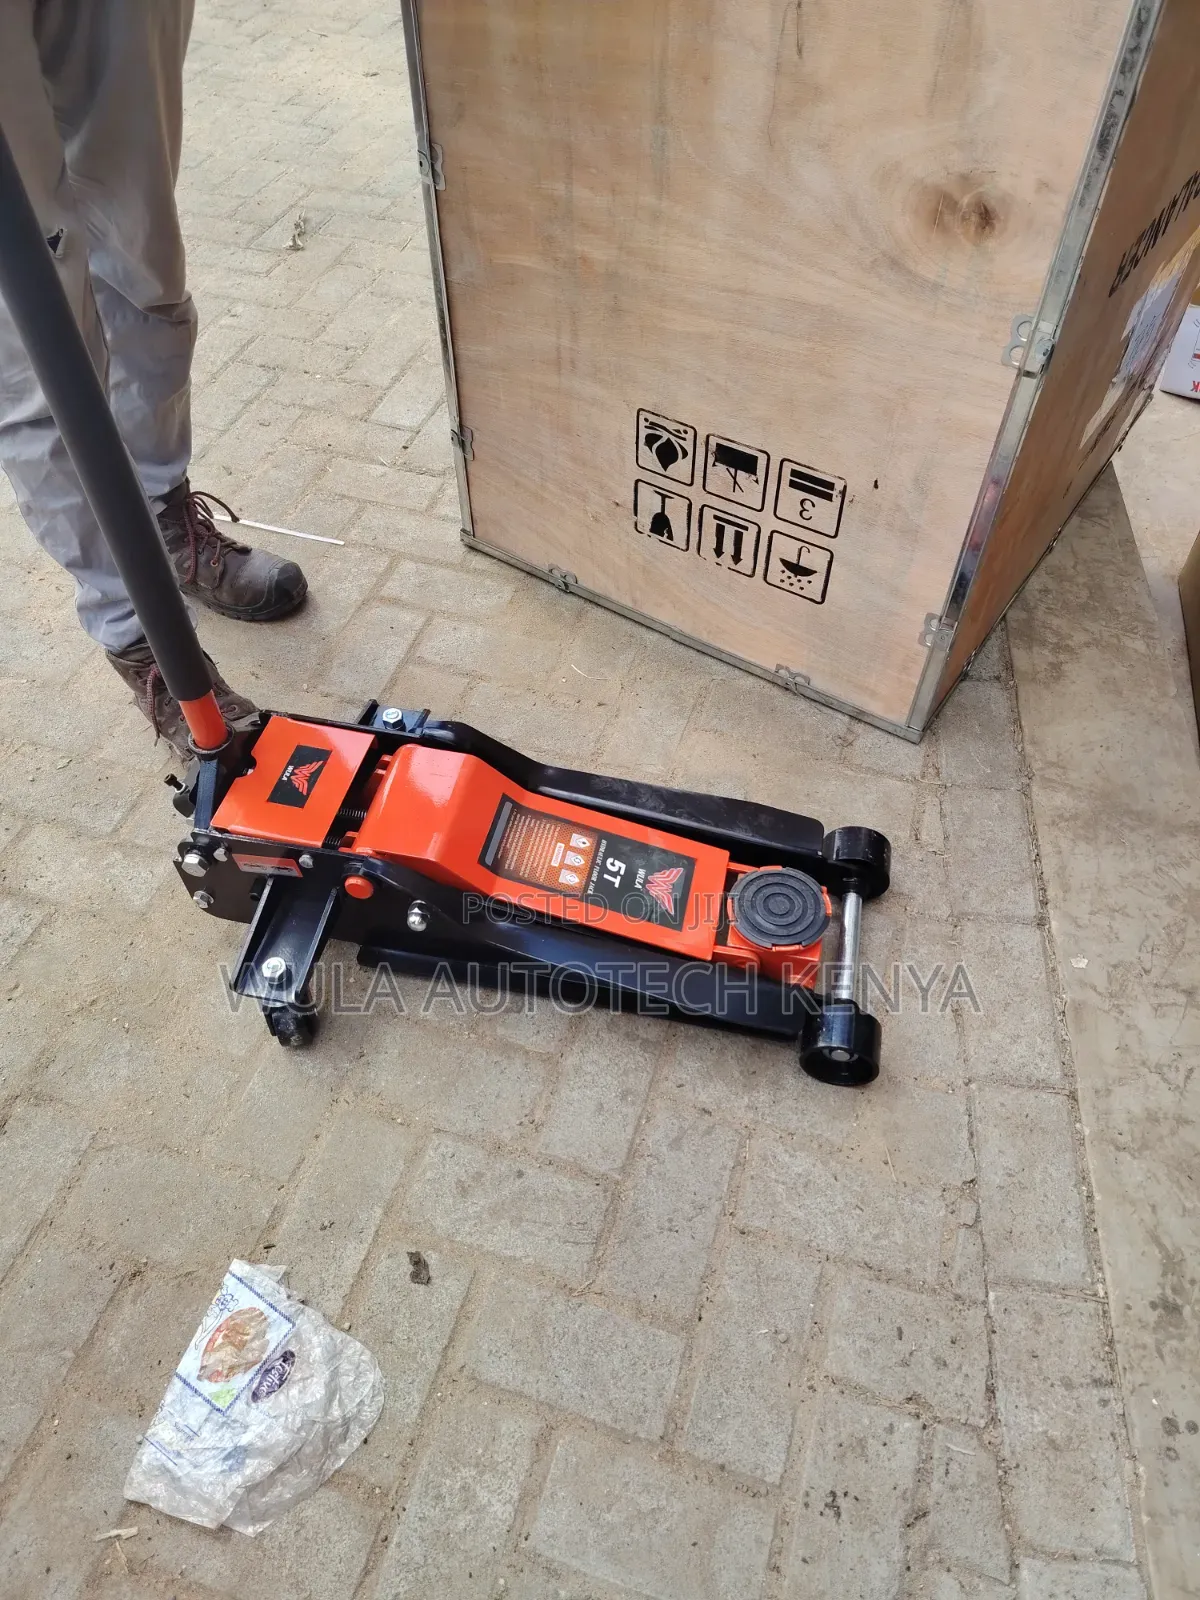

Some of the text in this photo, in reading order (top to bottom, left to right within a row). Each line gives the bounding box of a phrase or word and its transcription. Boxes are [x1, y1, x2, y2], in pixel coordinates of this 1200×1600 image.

[586, 840, 607, 895] HYDRAULIC FLOOR JACK
[603, 857, 626, 889] 5T
[633, 867, 647, 889] WULA
